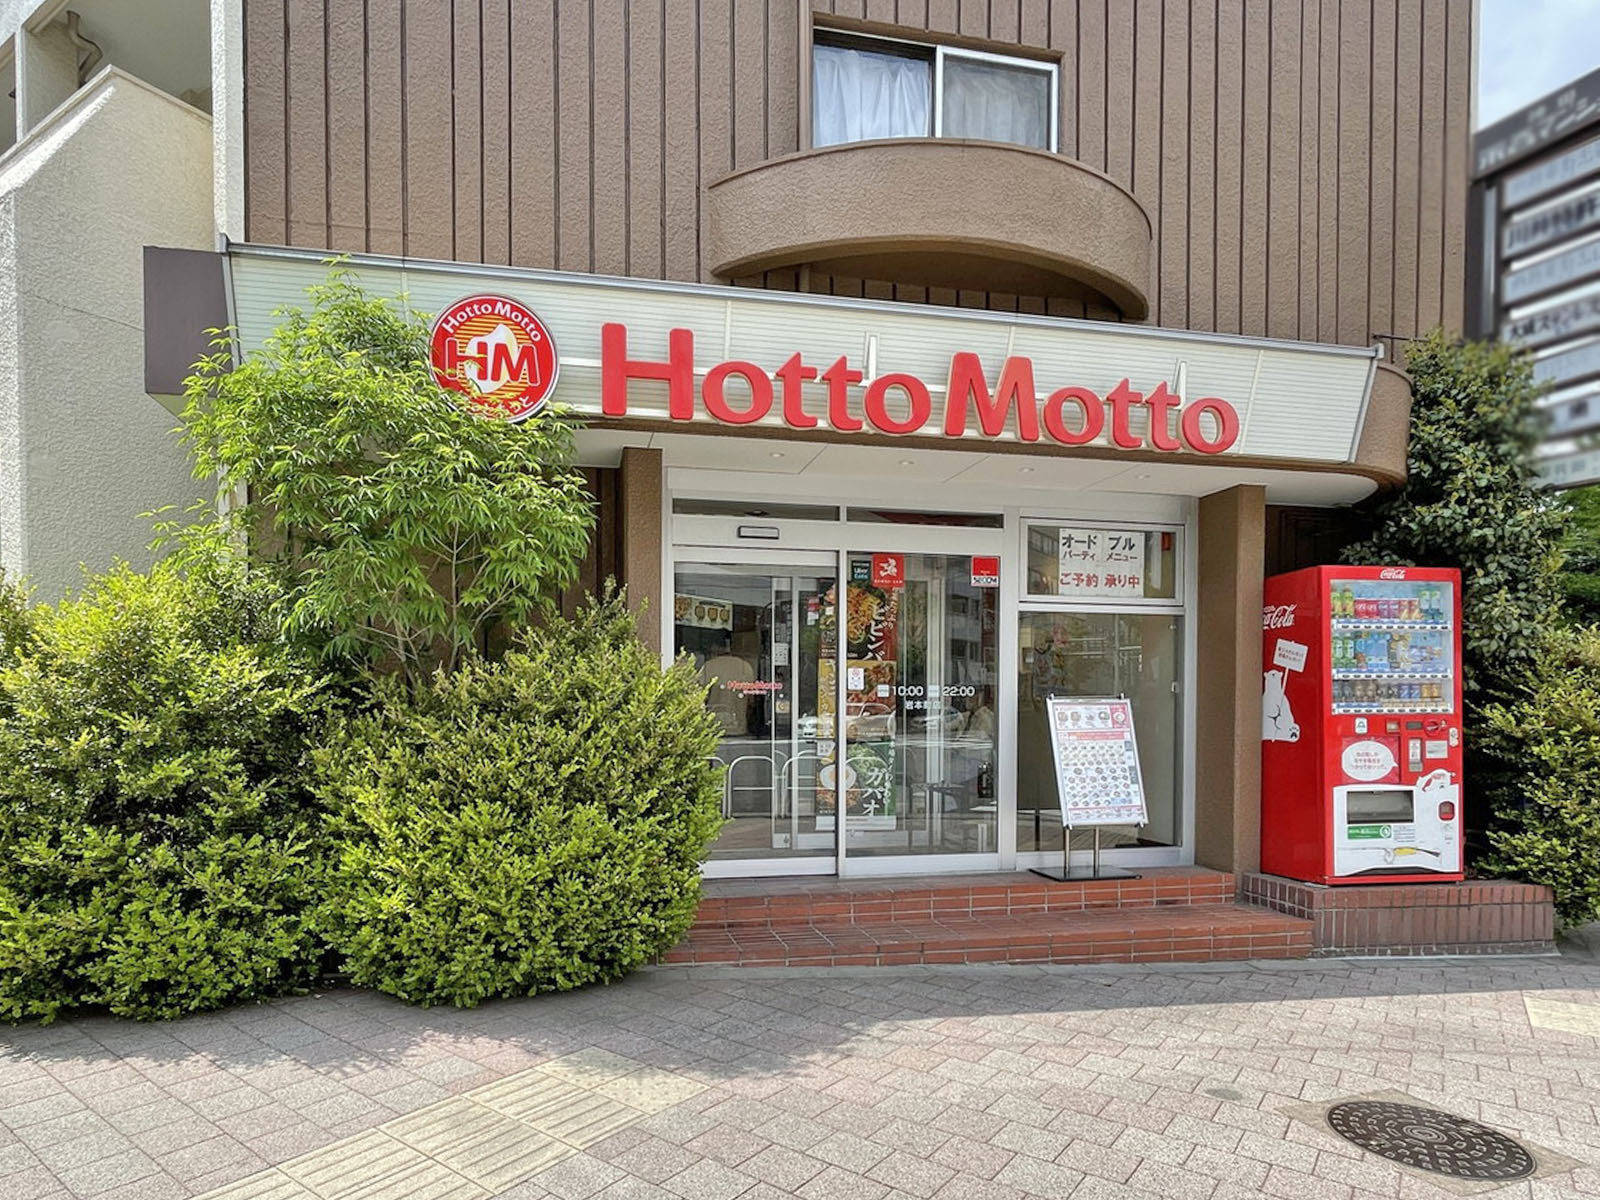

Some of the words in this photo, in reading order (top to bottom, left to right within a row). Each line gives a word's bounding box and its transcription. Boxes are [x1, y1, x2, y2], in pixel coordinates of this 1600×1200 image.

[1060, 572, 1099, 588] ご予約
[942, 686, 975, 697] 22:00
